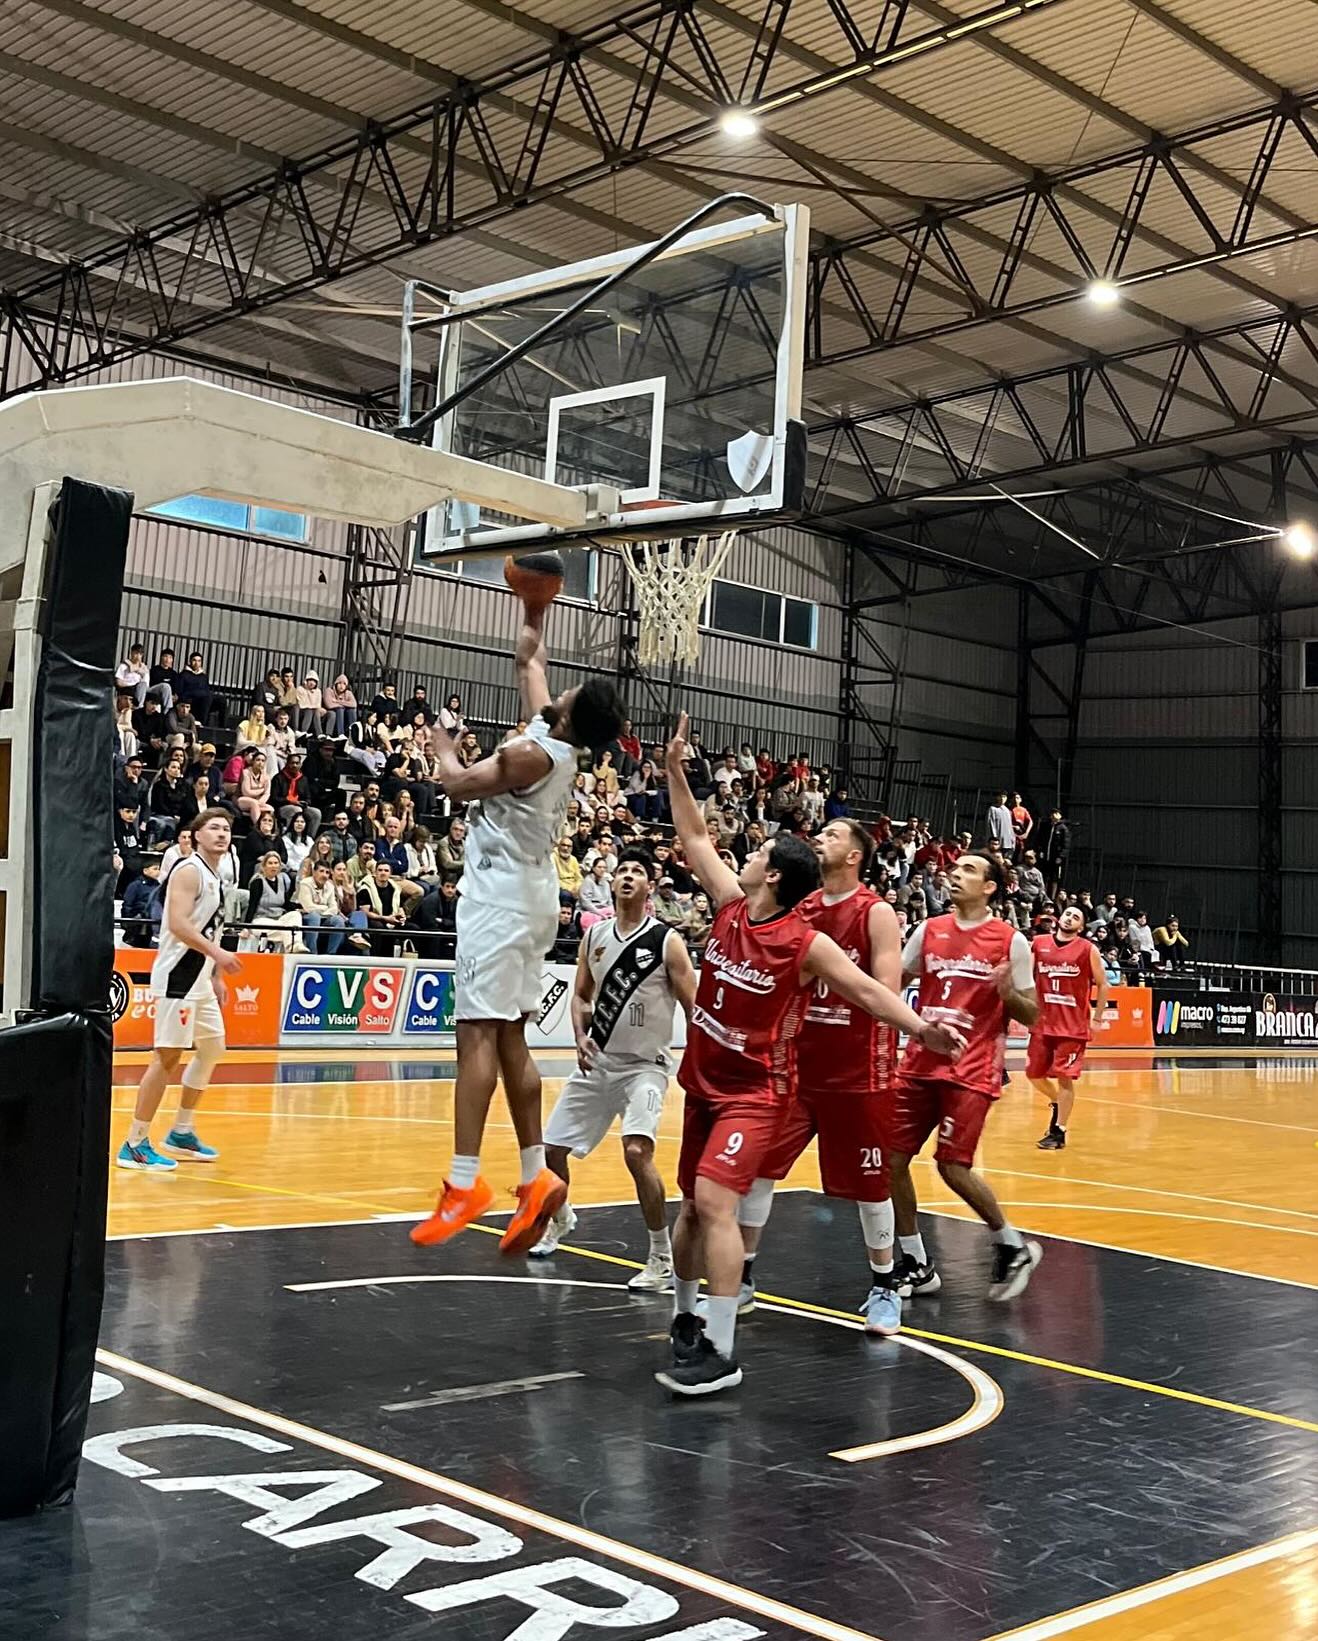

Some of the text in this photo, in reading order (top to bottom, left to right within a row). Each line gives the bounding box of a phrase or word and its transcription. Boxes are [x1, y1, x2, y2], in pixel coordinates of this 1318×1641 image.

[713, 987, 724, 1010] 9
[941, 980, 952, 1001] 5
[292, 1013, 390, 1026] Cable Visión Salto
[411, 1014, 438, 1027] Cable
[628, 1002, 645, 1027] 11
[1180, 1006, 1214, 1021] macro
[1255, 1011, 1314, 1037] BRANCA
[724, 1131, 744, 1155] 9
[860, 1147, 882, 1168] 20
[81, 1422, 767, 1641] CARR
